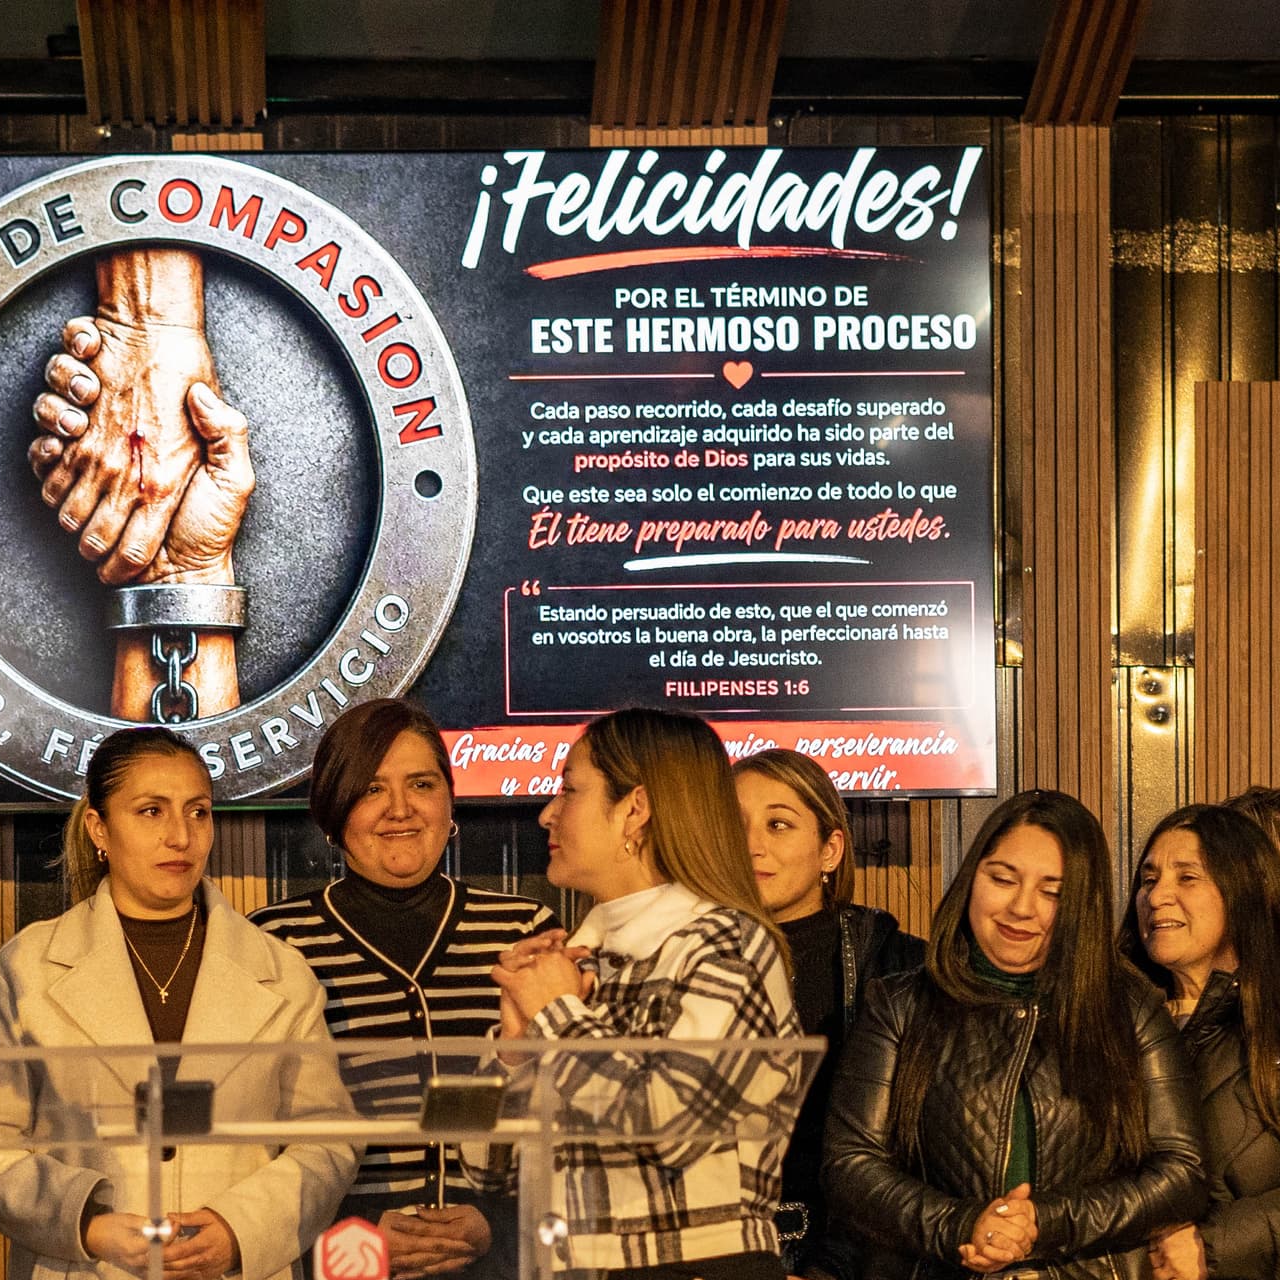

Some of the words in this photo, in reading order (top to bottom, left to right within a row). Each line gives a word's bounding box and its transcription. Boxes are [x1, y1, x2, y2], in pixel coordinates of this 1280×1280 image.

[461, 147, 982, 268] ¡Felicidades!
[615, 287, 668, 309] POR
[674, 287, 705, 308] EL
[710, 281, 827, 308] TÉRMINO
[834, 285, 869, 307] DE
[531, 318, 614, 354] ESTE
[626, 315, 800, 353] HERMOSO
[814, 313, 978, 352] PROCESO
[530, 401, 580, 420] Cada
[584, 404, 631, 424] paso
[635, 399, 727, 420] recorrido,
[731, 398, 778, 418] cada
[782, 398, 852, 417] desafío
[855, 397, 946, 421] superado
[521, 431, 535, 449] y
[538, 426, 585, 445] cada
[588, 425, 698, 449] aprendizaje
[702, 423, 793, 447] adquirido
[797, 423, 821, 442] ha
[824, 422, 865, 442] sido
[868, 423, 920, 445] parte
[923, 421, 955, 441] del
[574, 450, 670, 473] propósito
[673, 449, 700, 468] de
[704, 448, 749, 468] Dios
[753, 452, 796, 472] para
[800, 451, 832, 467] sus
[835, 447, 891, 466] vidas.
[522, 485, 565, 506] Que
[568, 486, 610, 504] este
[614, 488, 647, 503] sea
[651, 483, 693, 503] solo
[696, 482, 716, 502] el
[719, 482, 813, 502] comienzo
[817, 481, 843, 501] de
[846, 481, 893, 500] todo
[897, 480, 916, 500] lo
[920, 484, 958, 503] que
[528, 505, 563, 550] Él
[566, 512, 634, 546] tiene
[634, 509, 773, 554] preparado
[774, 518, 843, 552] para
[847, 507, 951, 544] ustedes.
[539, 604, 608, 622] Estando
[611, 602, 706, 625] persuadido
[708, 602, 732, 620] de
[734, 603, 776, 621] esto,
[779, 605, 813, 622] que
[815, 601, 832, 618] el
[835, 604, 868, 622] que
[871, 598, 949, 619] comenzó
[531, 631, 554, 645] en
[557, 628, 632, 645] vosotros
[635, 627, 651, 644] la
[655, 626, 709, 644] buena
[712, 625, 757, 645] obra,
[761, 625, 777, 642] la
[780, 623, 899, 646] perfeccionará
[902, 621, 950, 641] hasta
[648, 650, 666, 668] el
[669, 649, 697, 668] día
[701, 649, 725, 667] de
[728, 648, 823, 667] Jesucristo.
[203, 592, 410, 781] SERVICIO
[783, 679, 810, 696] 1:6
[449, 733, 547, 770] Gracias
[794, 730, 959, 758] perseverancia
[828, 764, 901, 791] servir.
